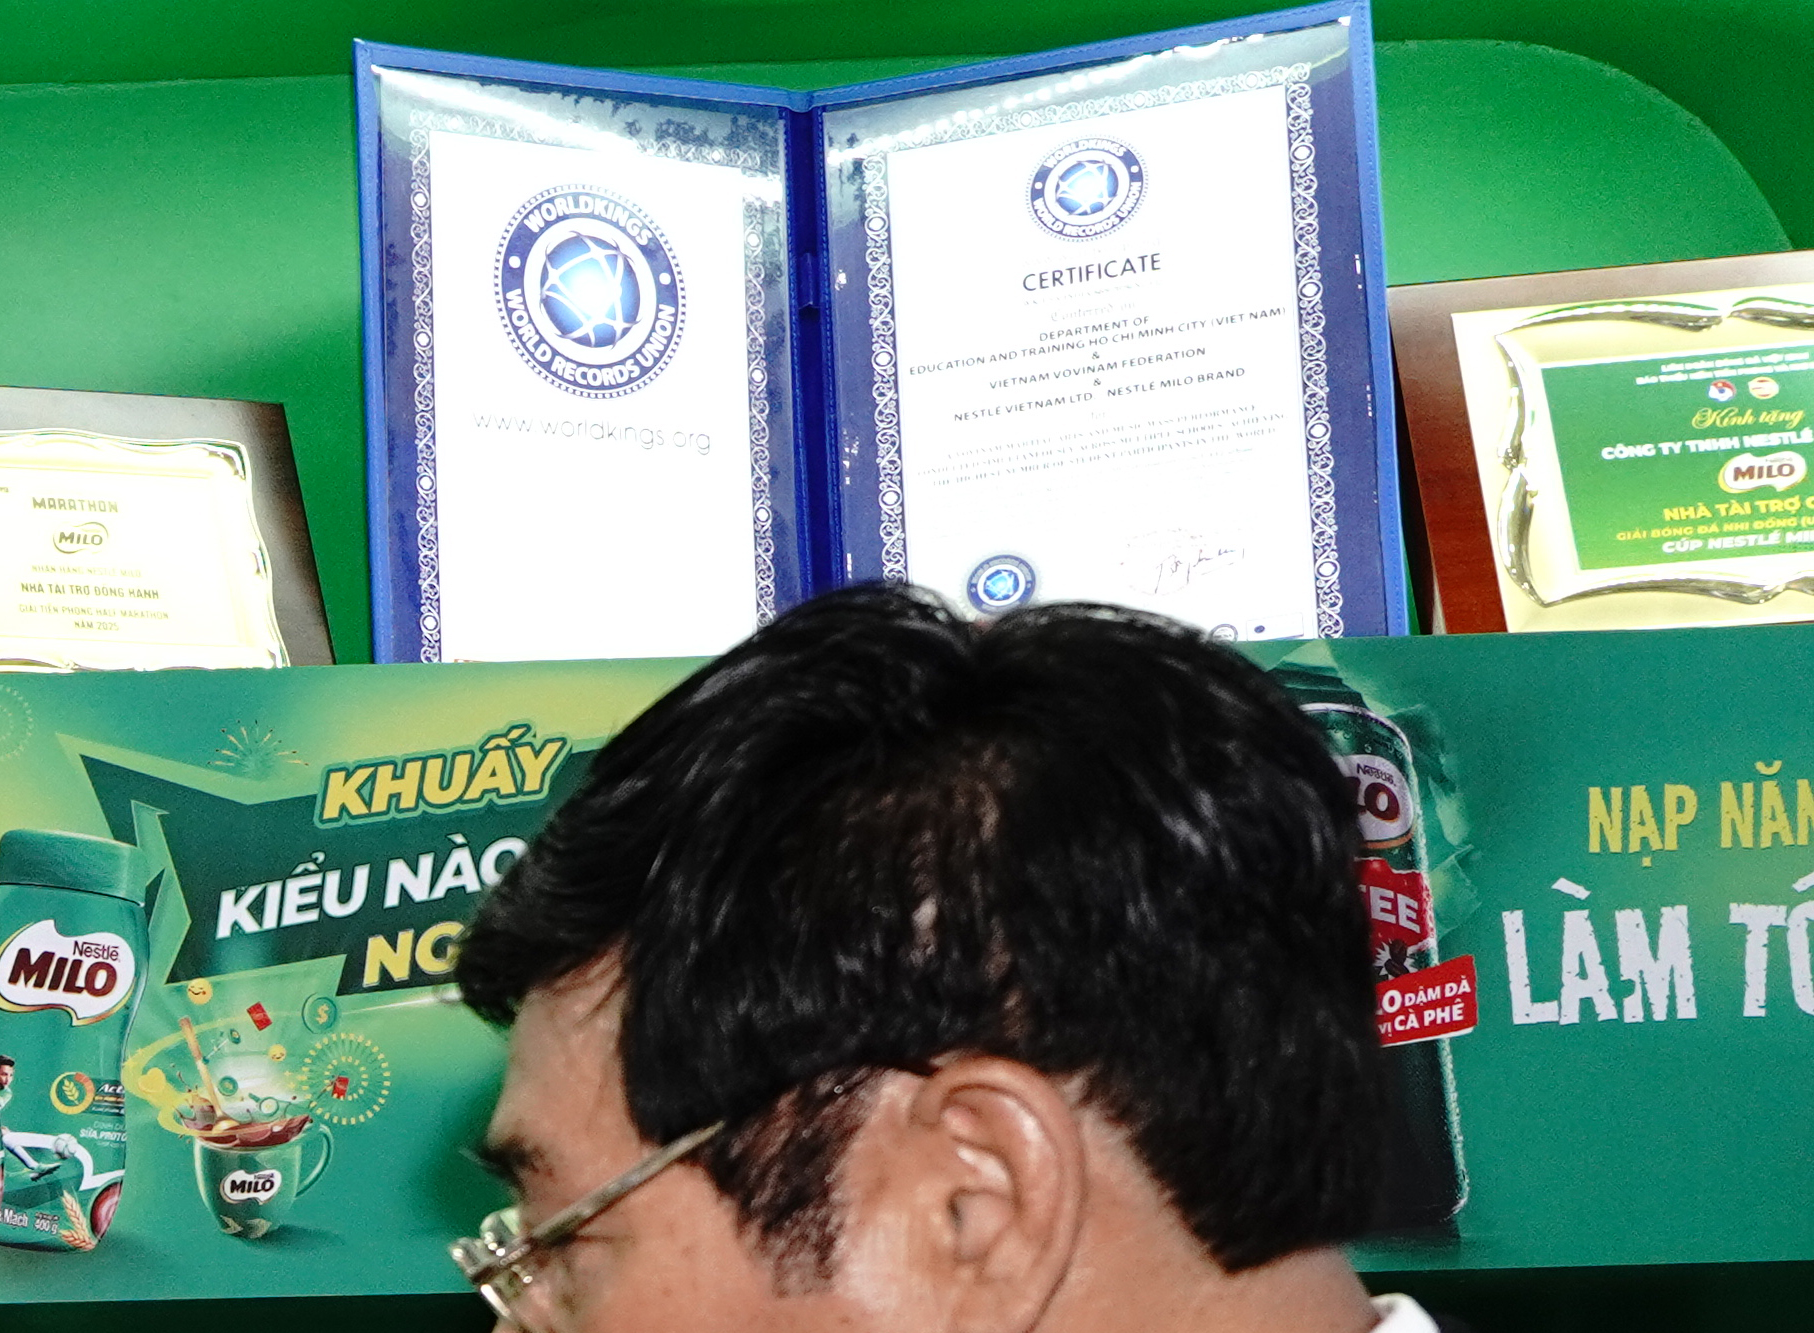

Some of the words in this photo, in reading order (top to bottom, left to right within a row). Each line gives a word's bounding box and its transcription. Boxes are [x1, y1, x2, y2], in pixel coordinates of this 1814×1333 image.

[524, 194, 653, 246] WORLDKINGS
[1022, 253, 1161, 291] CERTIFICATE
[506, 288, 552, 363] WORLD
[551, 356, 641, 386] RECORDS
[636, 304, 676, 368] UNION
[909, 357, 985, 376] EDUCATION
[989, 351, 1018, 364] AND
[1022, 339, 1085, 358] TRAINING
[1089, 336, 1108, 347] HO
[1112, 332, 1134, 343] CHI
[1139, 326, 1174, 339] MINH
[1178, 319, 1207, 332] CITY
[1040, 319, 1129, 342] DEPARTMENT
[1133, 315, 1150, 327] OF
[990, 372, 1050, 389] VIETNAM
[1054, 362, 1118, 379] VOVINAM
[1122, 348, 1206, 368] FEDERATION
[1005, 396, 1065, 413] VIETNAM
[1160, 374, 1193, 389] MILO
[1197, 368, 1245, 383] BRAND
[473, 413, 710, 455] www.worldkings.org
[1601, 443, 1656, 460] CÔNG
[1658, 442, 1683, 455] TY
[1685, 437, 1740, 452] TNHH
[1733, 463, 1795, 482] MILO
[33, 497, 118, 513] MARATHON
[1663, 502, 1712, 521] NHÀ
[1715, 500, 1752, 517] TÀI
[1756, 495, 1801, 513] TRỢ
[59, 532, 103, 546] MILO
[1662, 538, 1702, 553] CÚP
[1708, 530, 1780, 550] NESTLÉ
[321, 726, 567, 821] KHUẤY
[1588, 783, 1698, 867] NẠP
[215, 850, 370, 940] KIỂU
[1501, 877, 1697, 1025] LÀM
[7, 948, 118, 997] MILO
[1394, 1011, 1420, 1032] CÀ
[1423, 998, 1464, 1026] PHÊ
[1404, 985, 1441, 1006] ĐẬM
[230, 1180, 274, 1193] MILO
